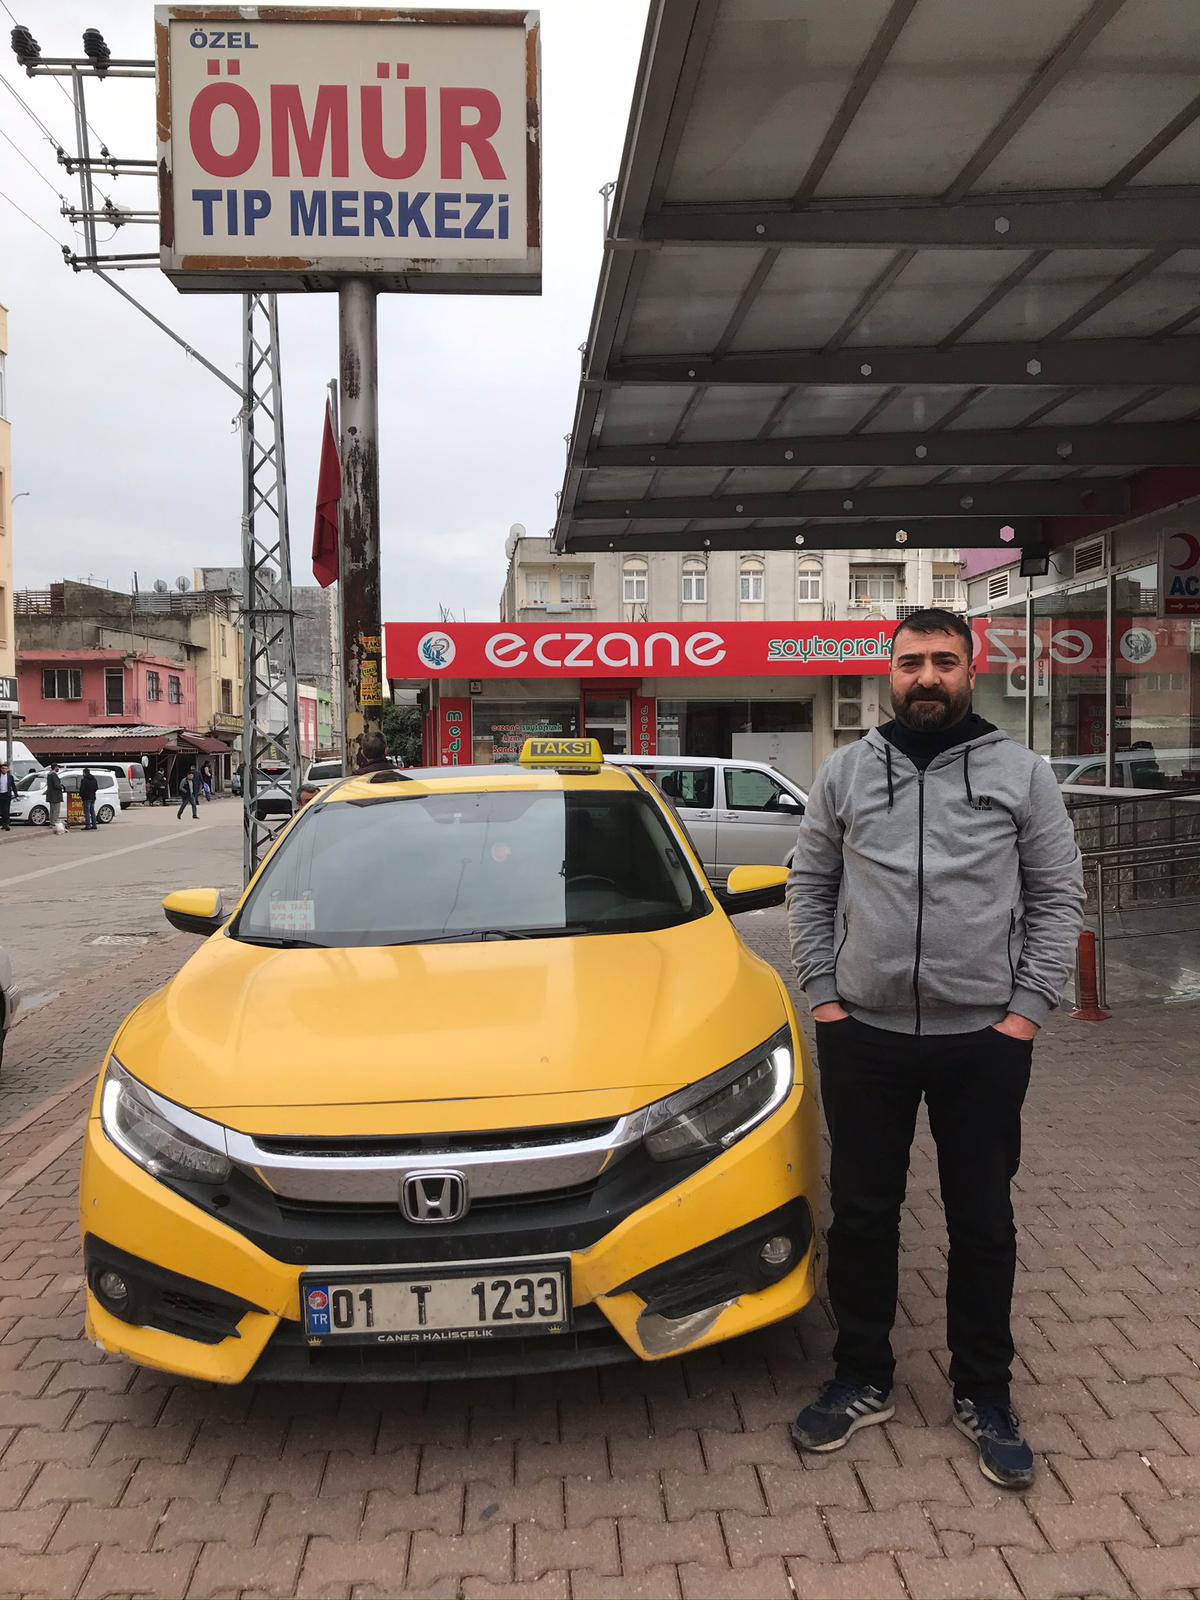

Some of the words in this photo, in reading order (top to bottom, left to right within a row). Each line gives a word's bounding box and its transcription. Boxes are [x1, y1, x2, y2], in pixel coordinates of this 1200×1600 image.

[189, 28, 259, 49] ÖZEL
[188, 59, 507, 180] ÖMÜR
[192, 189, 272, 237] TIP
[484, 631, 727, 668] eczane
[768, 632, 893, 663] soytoprak
[446, 710, 463, 766] medi
[312, 1313, 328, 1325] TR
[332, 1288, 374, 1328] 01
[410, 1285, 432, 1325] T
[471, 1277, 558, 1321] 1233
[377, 1334, 420, 1342] CANER
